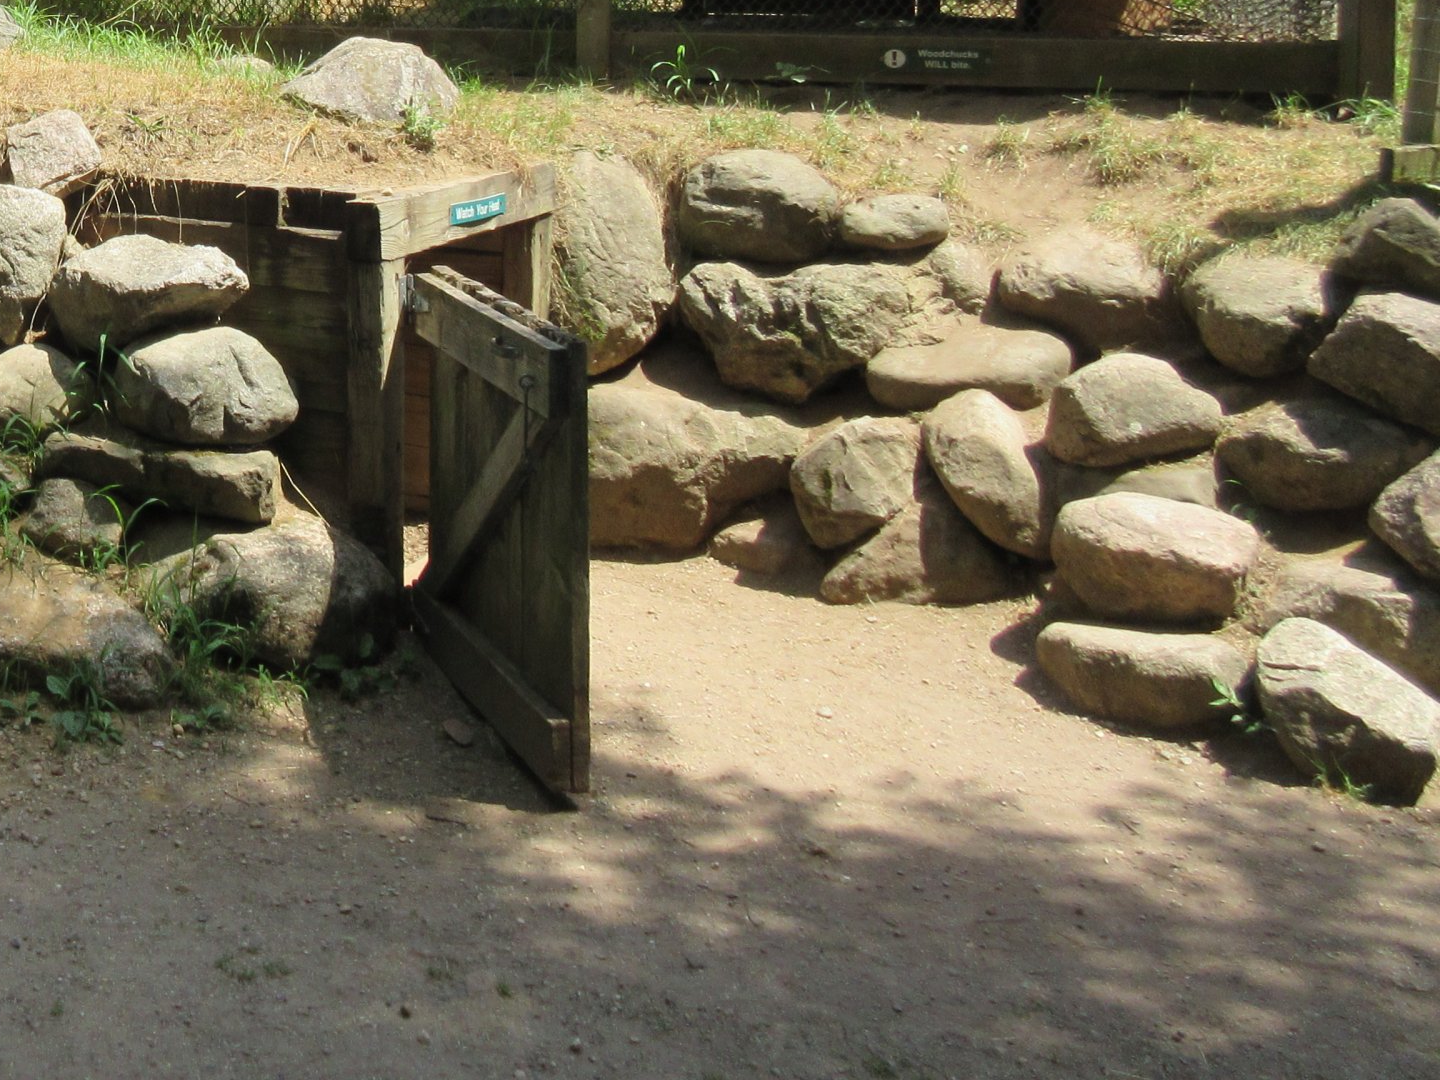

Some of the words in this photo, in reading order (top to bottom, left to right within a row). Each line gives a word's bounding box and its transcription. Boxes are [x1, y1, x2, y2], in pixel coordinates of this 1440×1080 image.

[917, 49, 979, 59] Woodchucks
[924, 60, 949, 69] WILL
[455, 205, 475, 220] Watch
[476, 203, 488, 216] Your
[488, 199, 500, 212] Head
